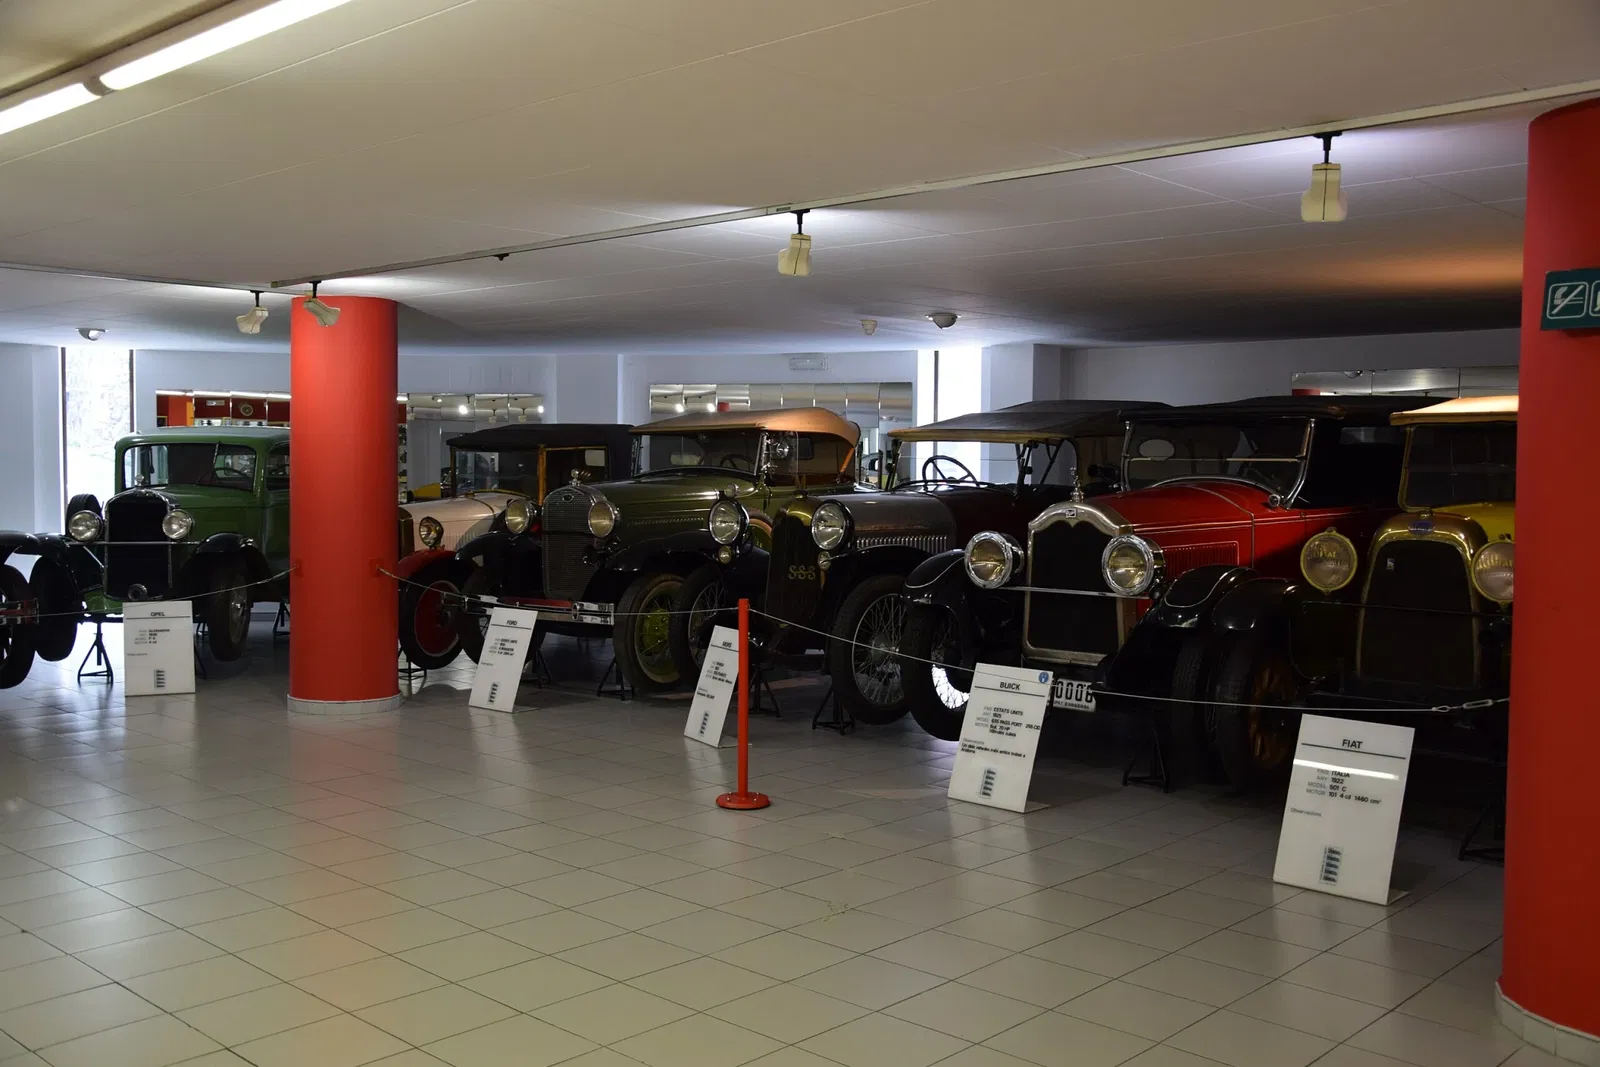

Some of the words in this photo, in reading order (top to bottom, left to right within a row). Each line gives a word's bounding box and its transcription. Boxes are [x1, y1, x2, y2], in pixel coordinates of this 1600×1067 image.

[1000, 681, 1021, 691] BUICK
[1342, 739, 1363, 749] FIAT
[1331, 770, 1350, 778] ITALIA
[1307, 781, 1326, 789] MODEL
[1305, 788, 1326, 796] MOTOR
